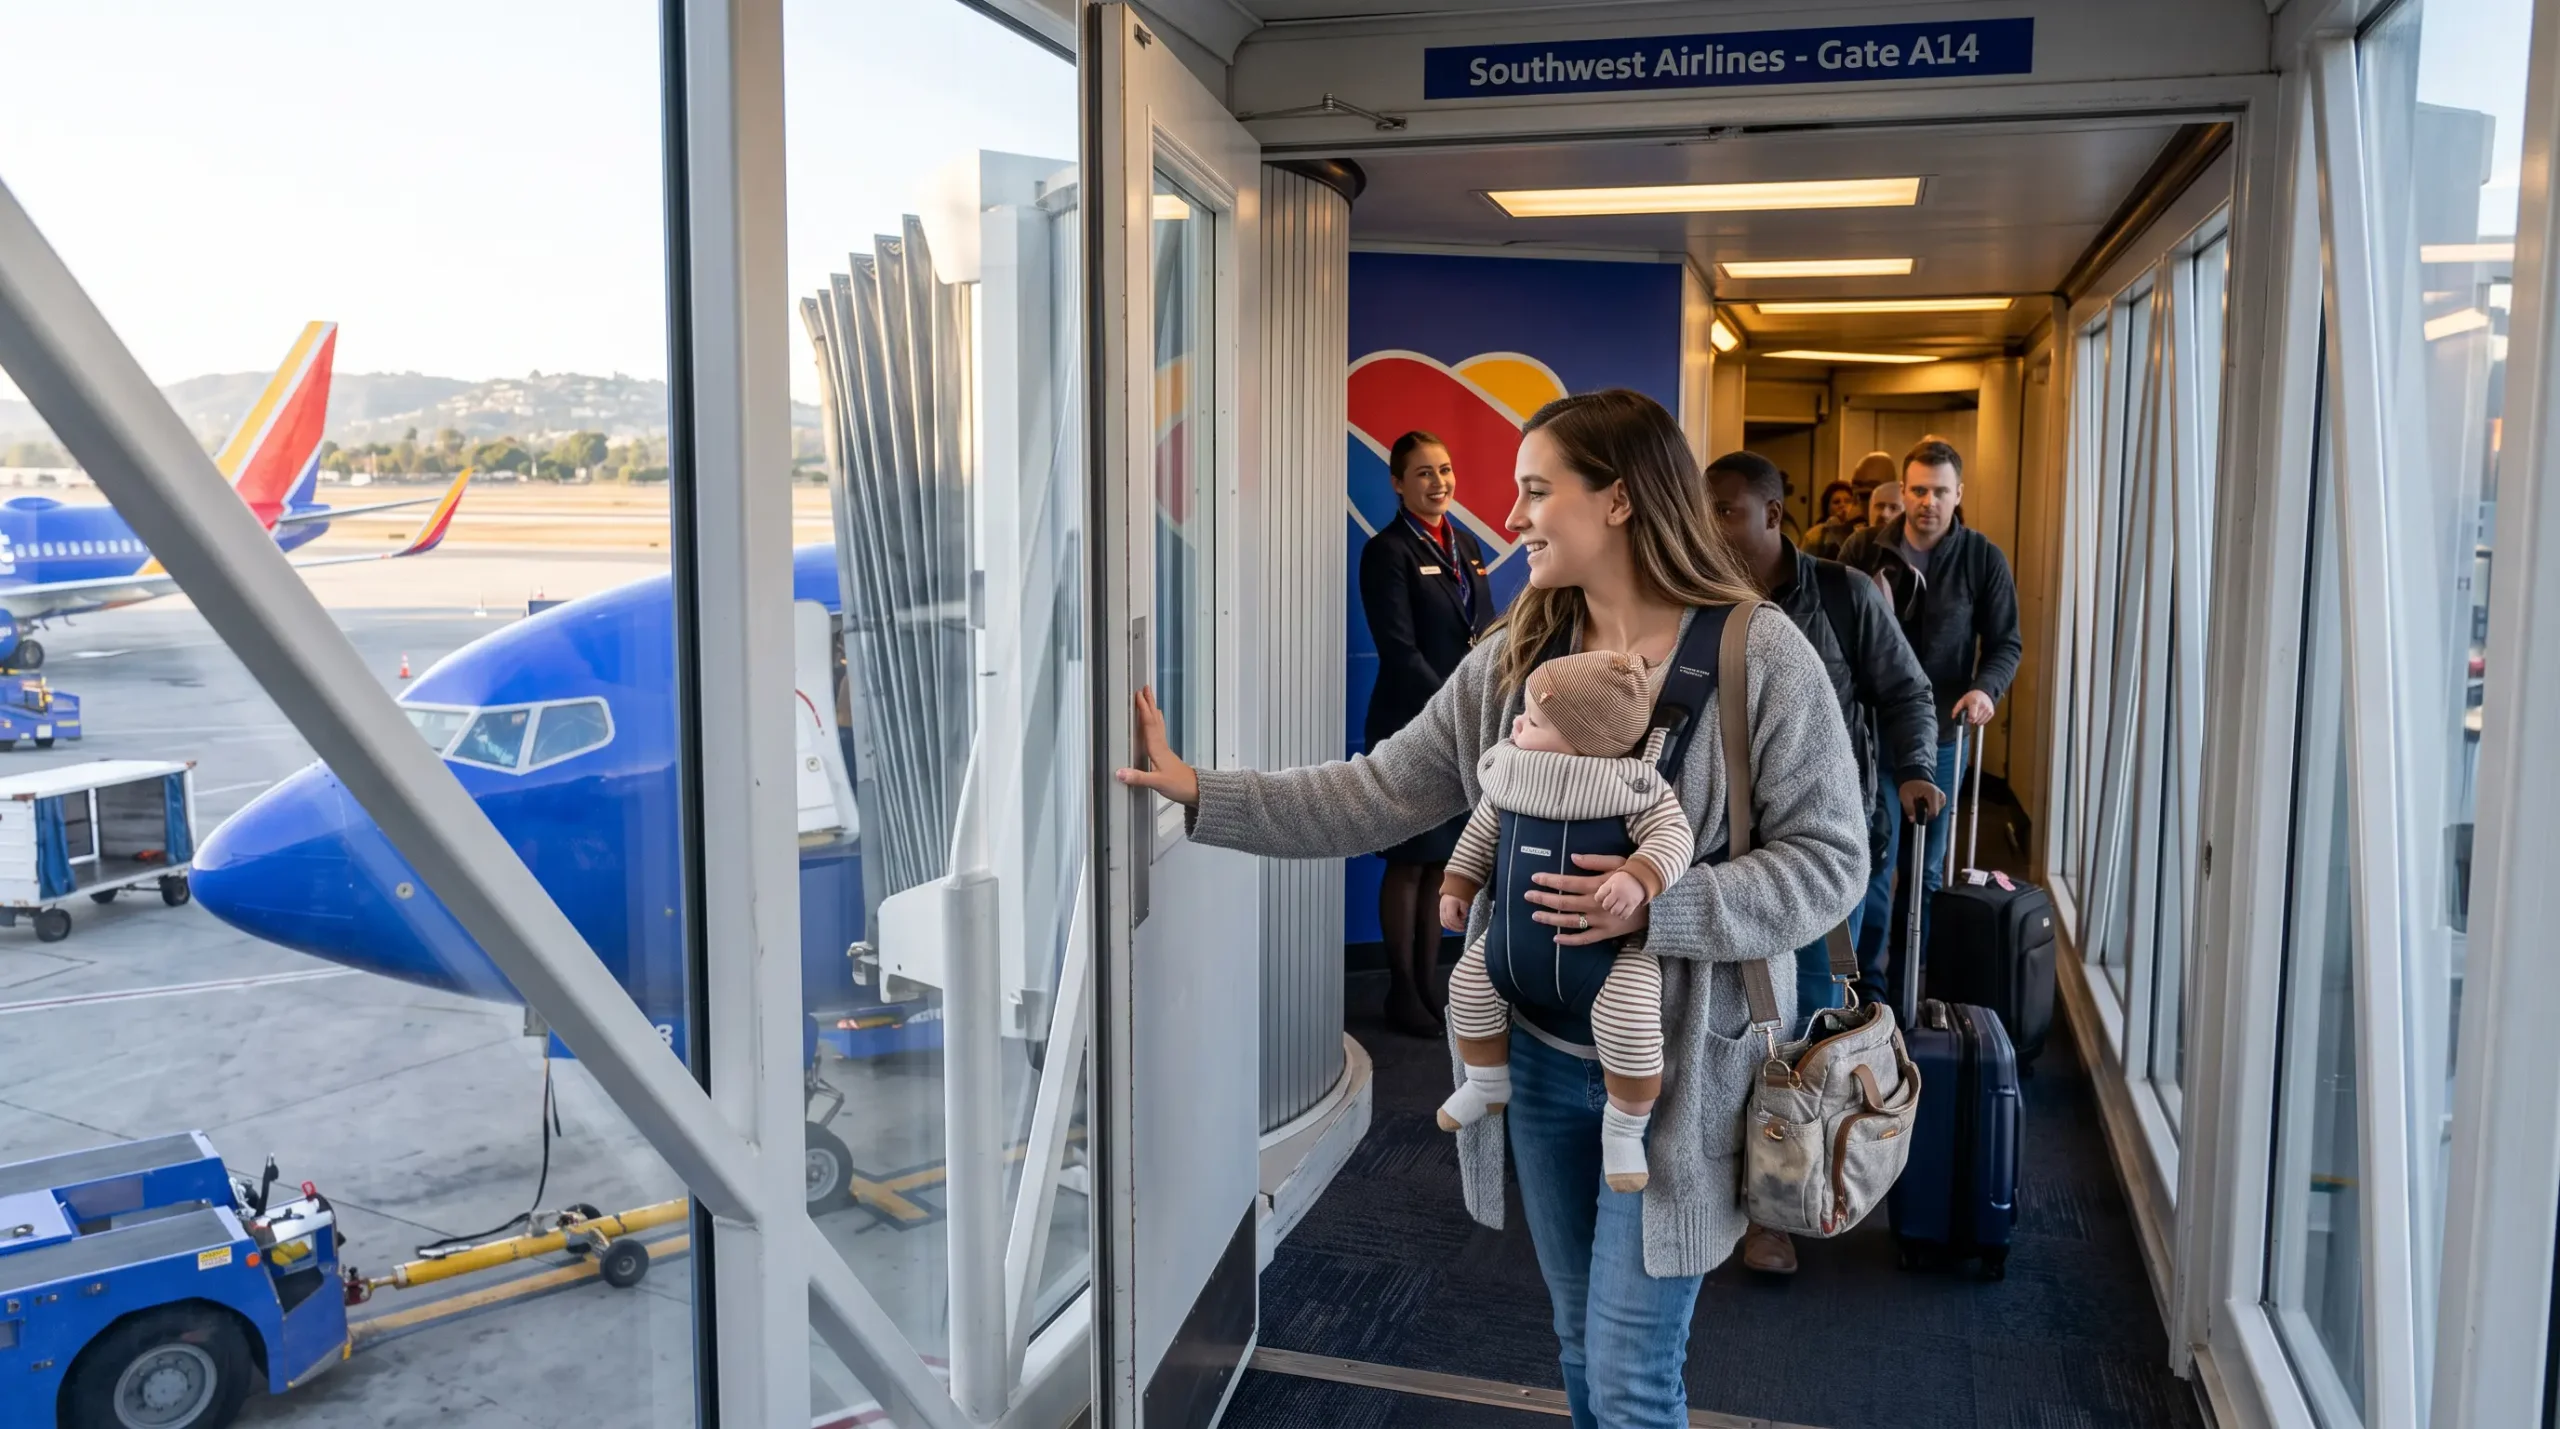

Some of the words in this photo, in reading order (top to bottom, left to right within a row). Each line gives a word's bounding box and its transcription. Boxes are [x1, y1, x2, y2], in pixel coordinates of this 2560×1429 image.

[1469, 52, 1646, 86] Southwest
[1653, 44, 1785, 77] Airlines
[1795, 55, 1808, 63] -
[1817, 40, 1901, 70] Gate
[1908, 33, 1980, 66] A14
